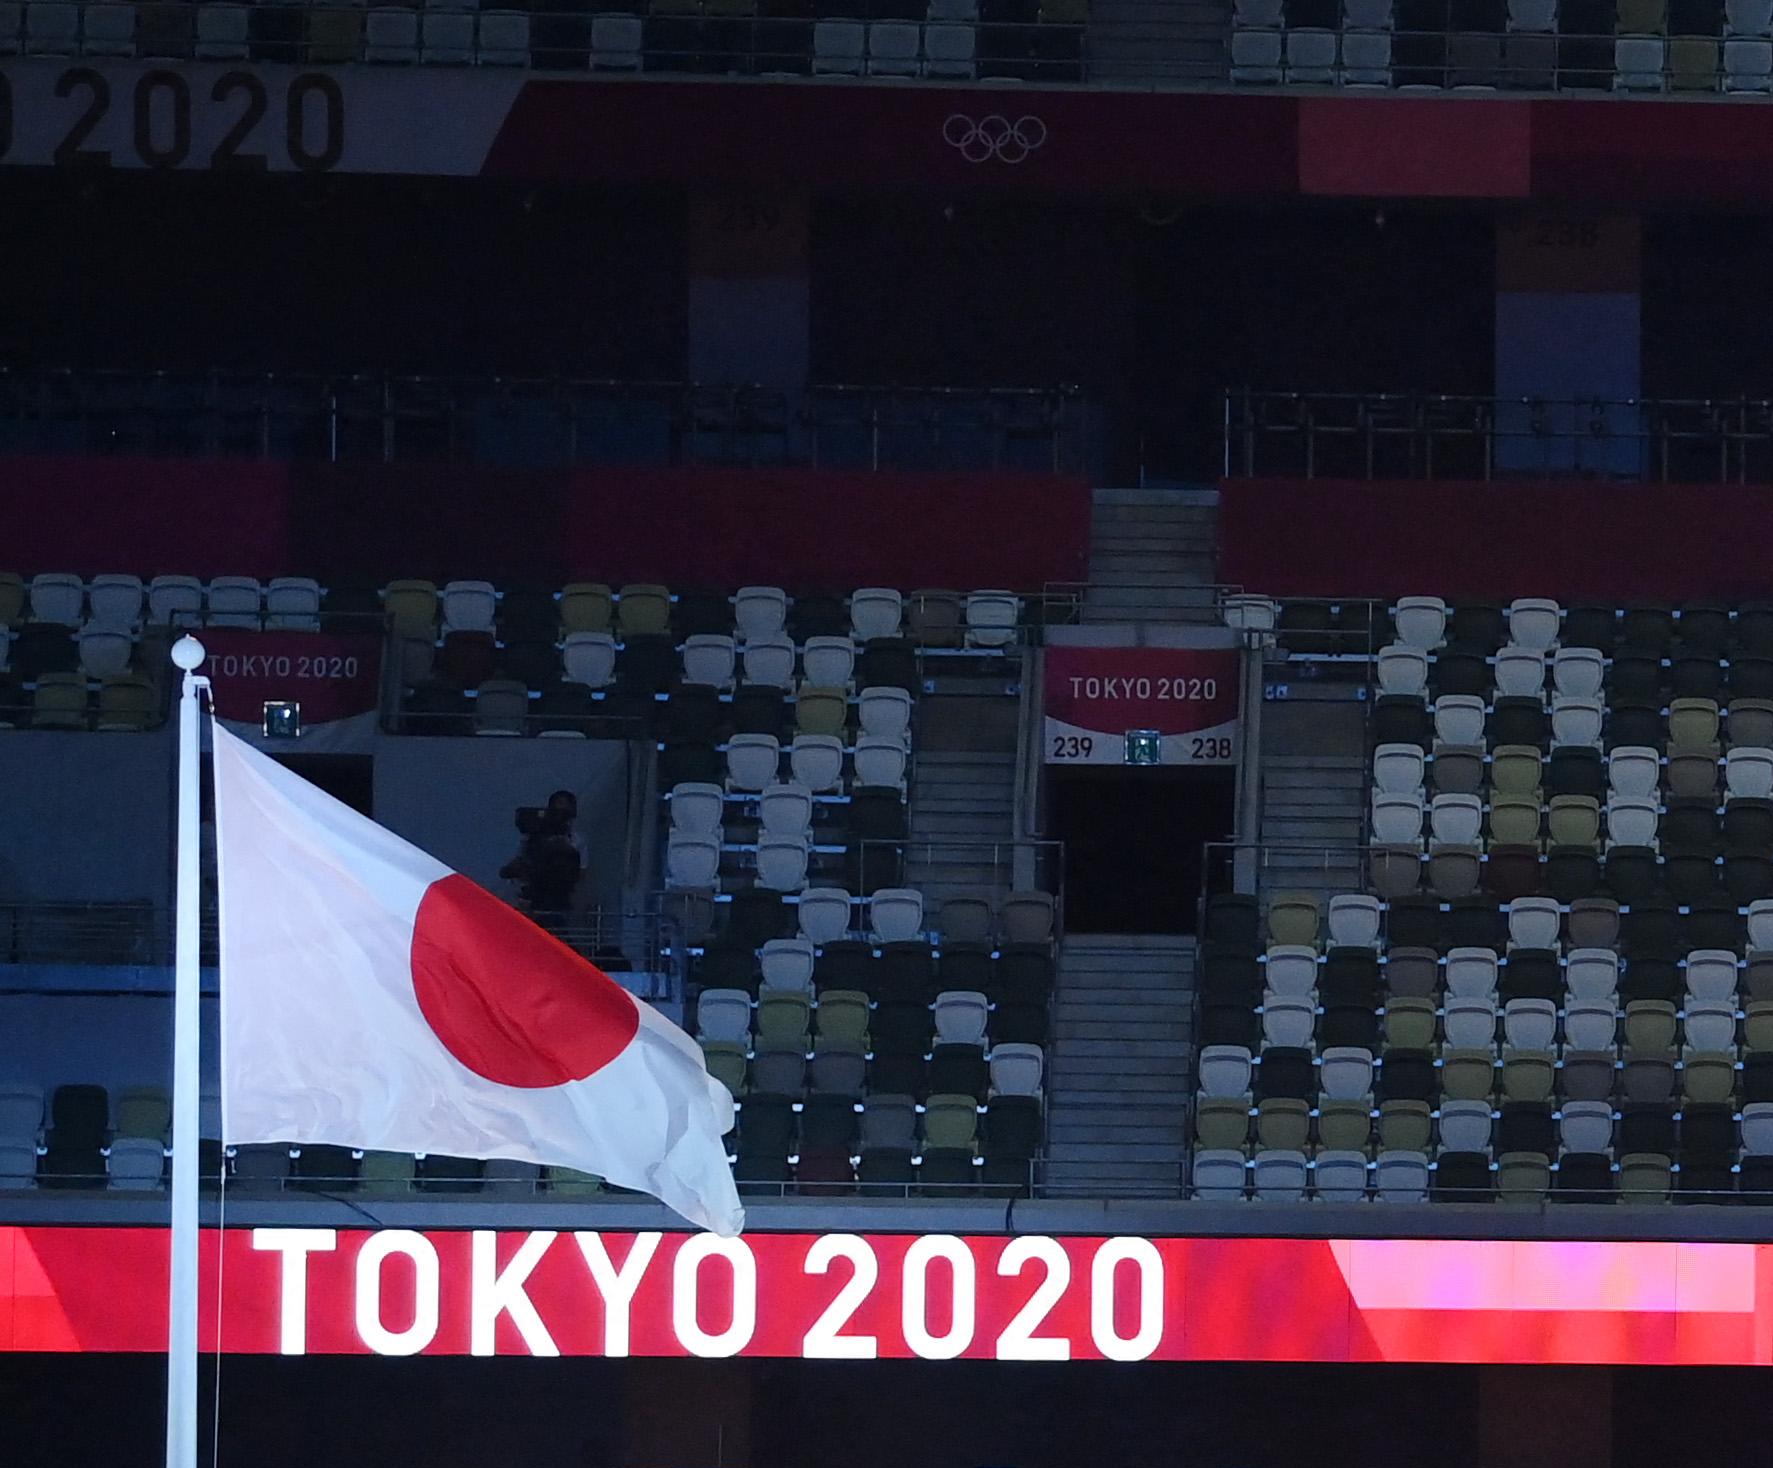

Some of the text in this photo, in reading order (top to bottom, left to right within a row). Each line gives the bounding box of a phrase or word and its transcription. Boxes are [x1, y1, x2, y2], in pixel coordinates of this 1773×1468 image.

[54, 67, 345, 172] 2020
[719, 204, 779, 231] 239
[1537, 219, 1598, 247] 238
[207, 655, 357, 678] TOKYO 2020
[1069, 677, 1217, 700] TOKYO 2020
[1054, 737, 1092, 758] 239
[1192, 738, 1231, 758] 238
[253, 1228, 1166, 1361] TOKYO 2020
